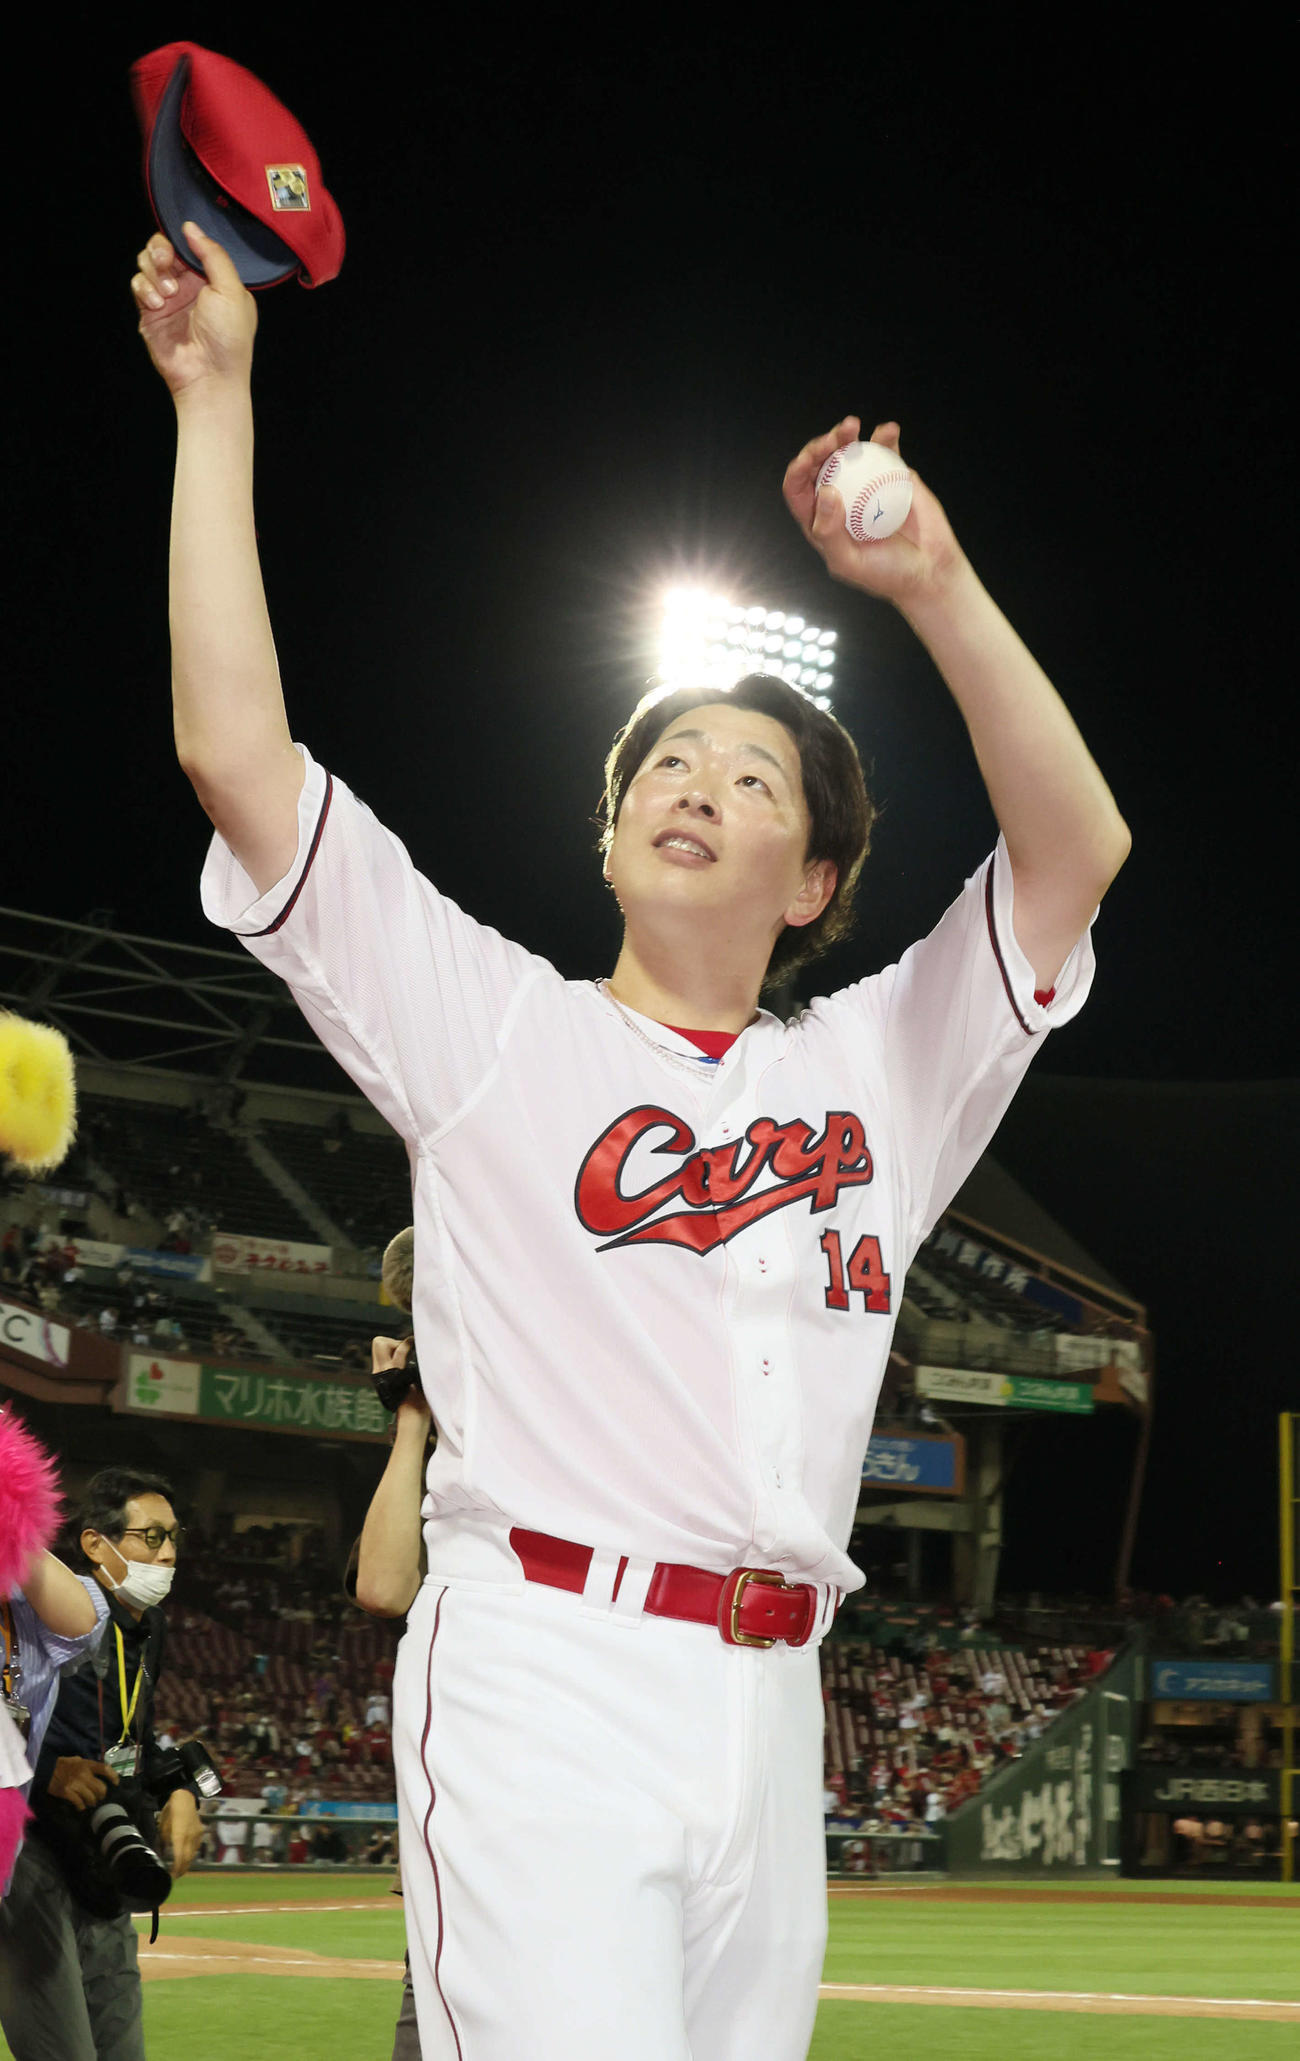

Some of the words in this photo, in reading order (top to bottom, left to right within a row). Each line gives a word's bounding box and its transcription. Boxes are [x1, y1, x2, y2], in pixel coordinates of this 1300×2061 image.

[574, 1104, 873, 1257] Carp
[820, 1228, 891, 1315] 14
[214, 1373, 385, 1433] マリホ水族館
